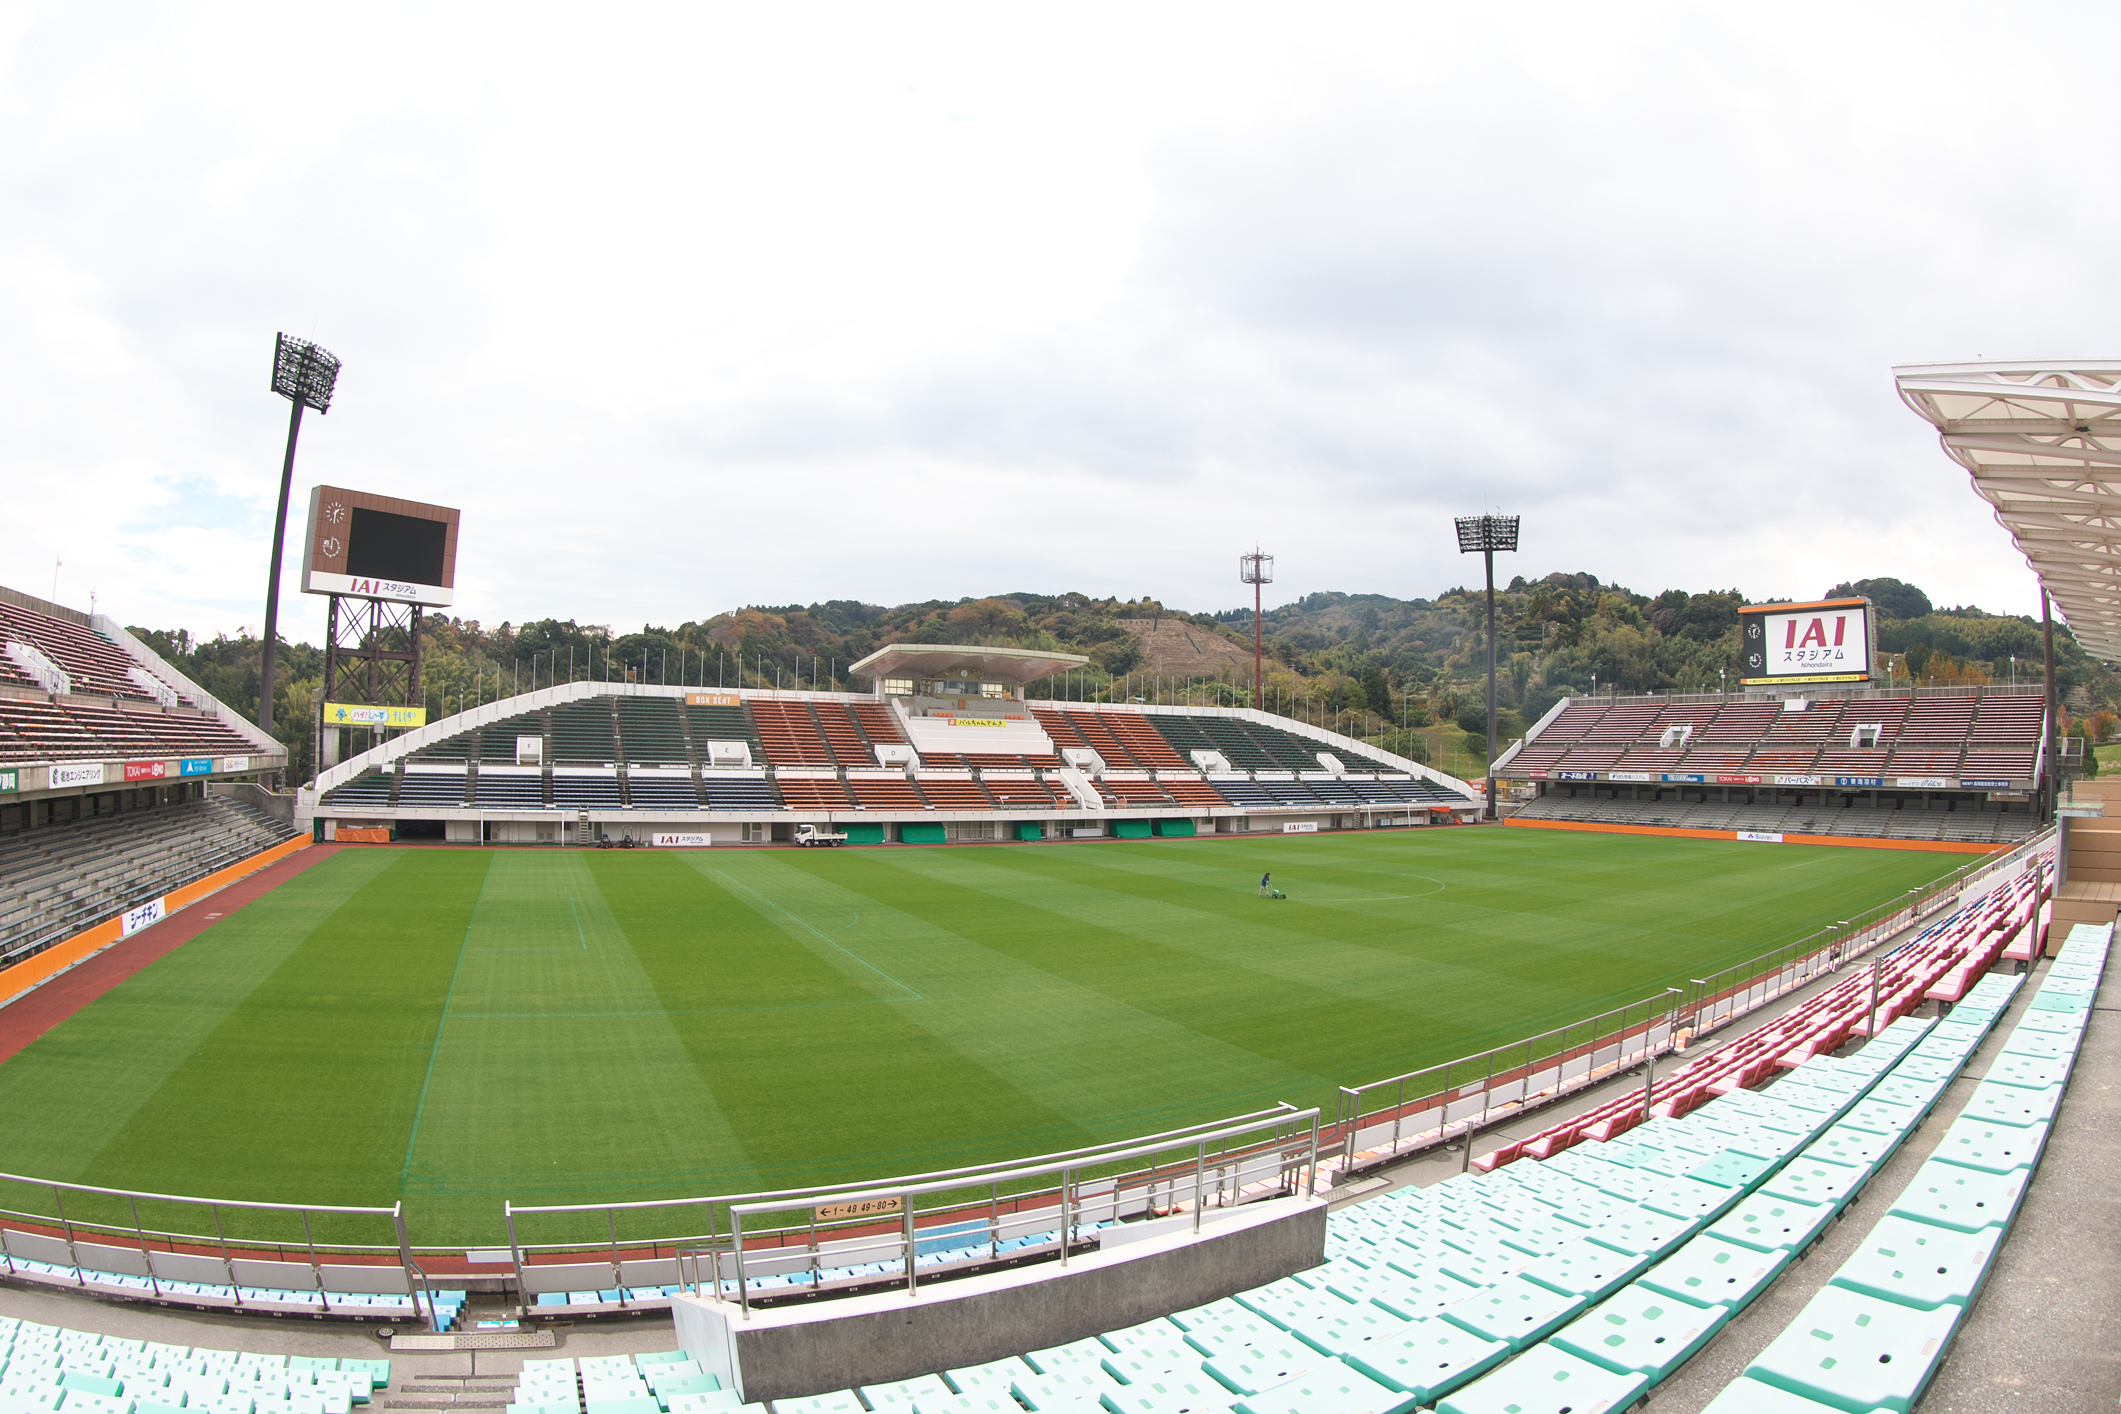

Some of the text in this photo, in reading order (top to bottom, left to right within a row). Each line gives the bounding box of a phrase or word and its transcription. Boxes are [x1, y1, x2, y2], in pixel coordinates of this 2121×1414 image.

[350, 578, 417, 595] IAI スタジアム
[1785, 616, 1846, 649] IAI
[1783, 649, 1844, 662] スタジアム
[695, 695, 731, 705] BOX SEAT
[126, 766, 140, 777] TOKAI
[661, 836, 679, 844] IAI
[130, 902, 159, 930] シーチキン
